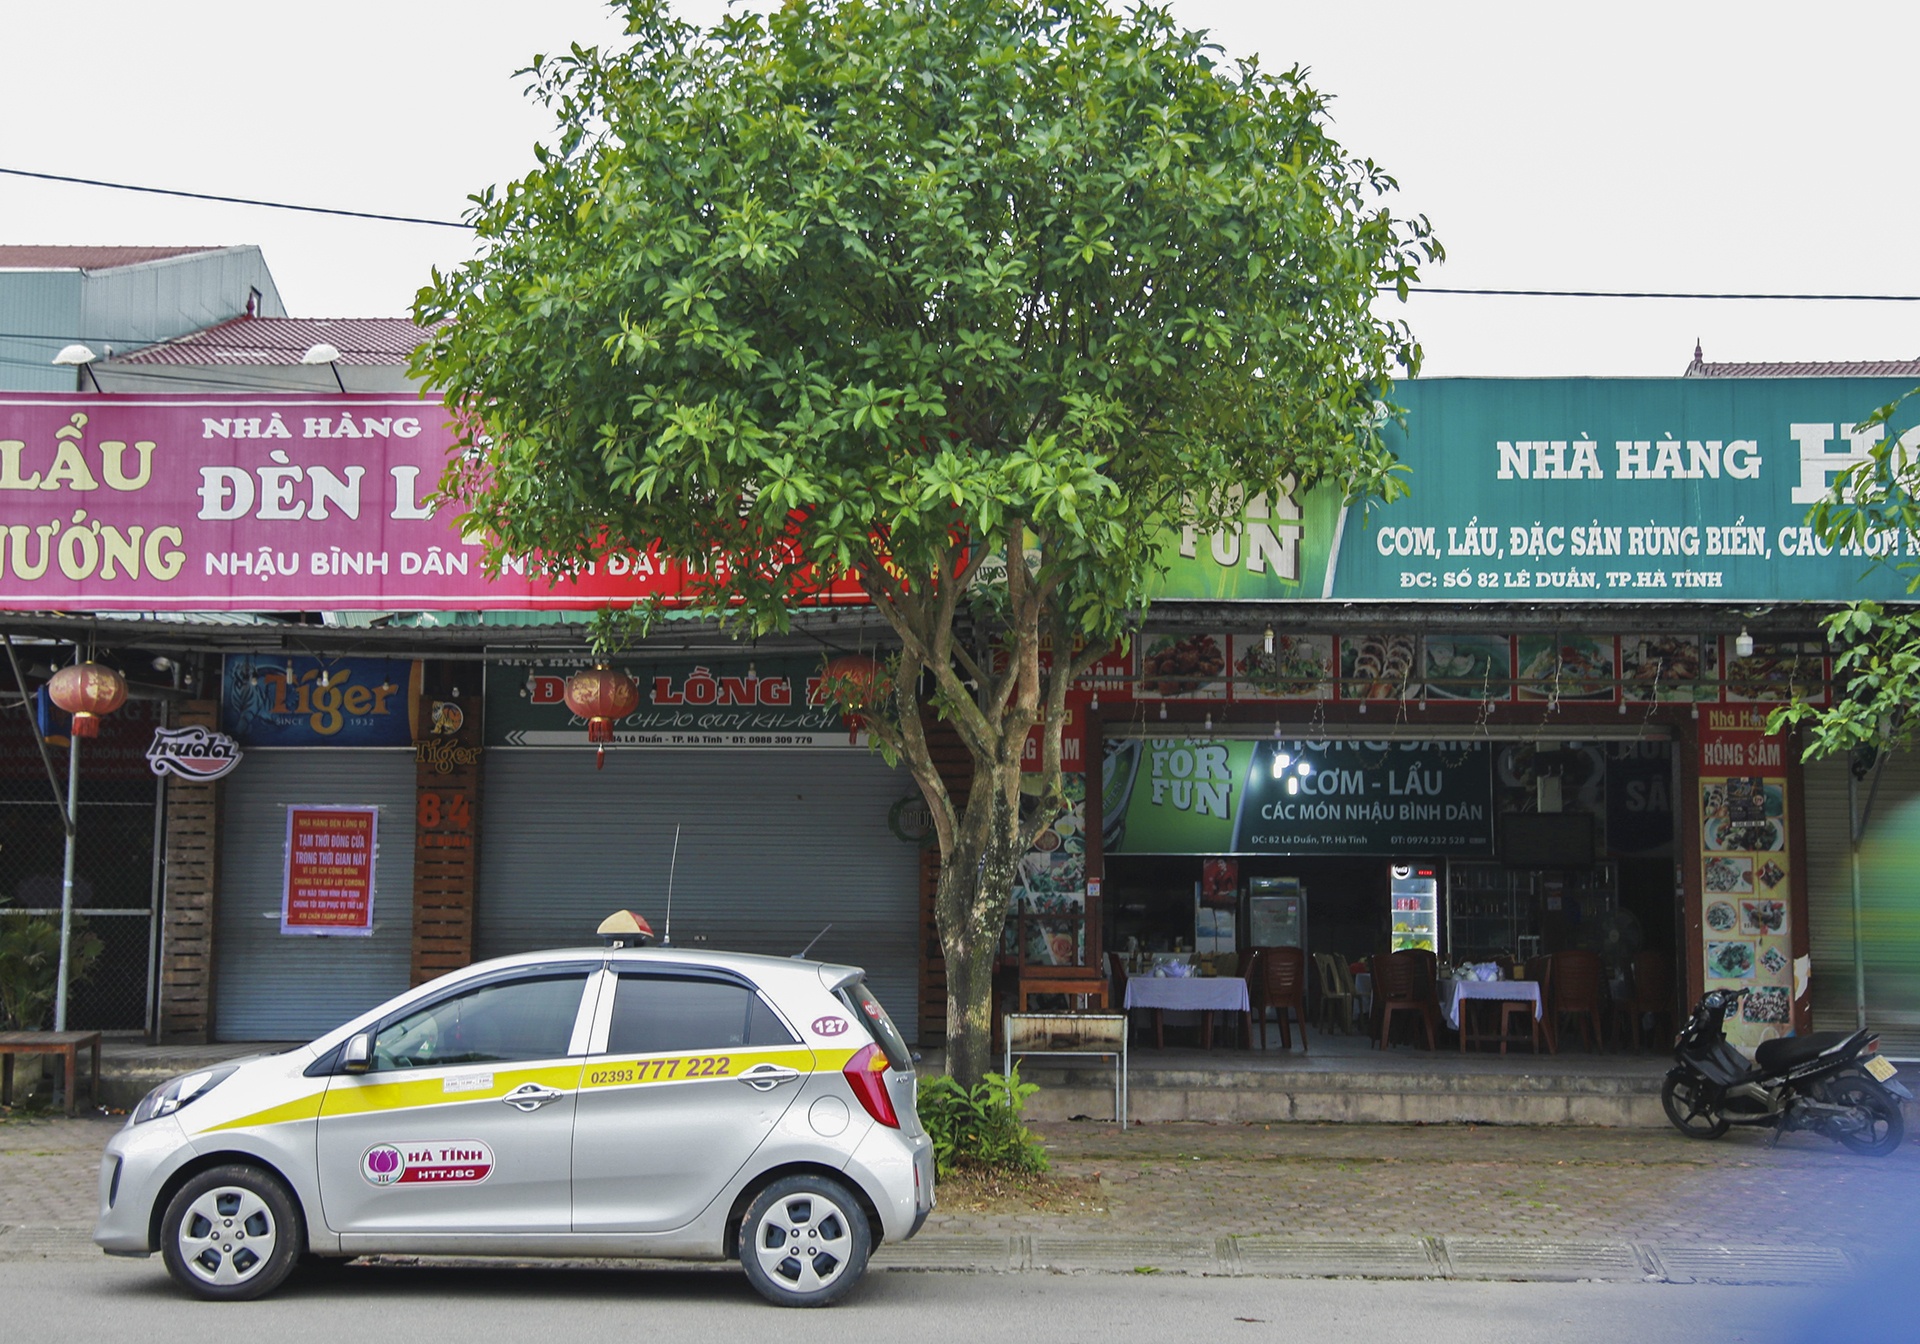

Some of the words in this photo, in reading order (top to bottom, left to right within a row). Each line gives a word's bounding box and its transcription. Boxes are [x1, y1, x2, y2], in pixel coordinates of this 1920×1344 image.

[202, 412, 292, 439] NHÀ
[302, 412, 422, 439] HÀNG
[0, 412, 157, 492] LẨU
[1497, 432, 1604, 480] NHÀ
[1615, 432, 1763, 480] HÀNG
[197, 449, 366, 521] ĐÈN
[0, 509, 187, 582] ƯỚNG
[1179, 521, 1303, 580] FUN
[1377, 526, 1441, 560] CƠM,
[1448, 515, 1504, 560] LẨU,
[1509, 520, 1565, 562] ĐẶC
[1570, 518, 1622, 556] SẢN
[1627, 519, 1700, 556] RỪNG
[1706, 515, 1772, 560] BIỂN,
[205, 546, 300, 582] NHẬU
[311, 546, 389, 576] BÌNH
[400, 546, 468, 576] DÂN
[1400, 571, 1437, 588] ĐC:
[1443, 567, 1473, 588] SỐ
[1477, 571, 1499, 588] 82
[1504, 569, 1531, 588] LÊ
[264, 669, 399, 735] Tiger
[652, 665, 792, 706] LỒNG
[276, 717, 303, 726] SINCE
[349, 718, 375, 726] 1932
[625, 710, 694, 728] CHÀO
[148, 730, 236, 762] huda
[411, 738, 483, 774] Tiger
[1151, 744, 1232, 780] FOR
[1748, 739, 1780, 766] SÂM
[1300, 767, 1364, 795] CƠM
[1389, 760, 1443, 795] LẨU
[418, 793, 472, 828] 84
[1151, 779, 1232, 819] FUN
[1261, 801, 1295, 820] CÁC
[1300, 801, 1341, 820] MÓN
[1345, 801, 1395, 825] NHẬU
[1399, 801, 1441, 820] BÌNH
[1445, 801, 1483, 820] DÂN
[1268, 836, 1280, 844] 82
[1406, 836, 1429, 845] 0974
[1430, 836, 1447, 845] 232
[1449, 836, 1465, 845] 528
[815, 1020, 845, 1034] 127
[591, 1069, 633, 1084] 02393
[637, 1060, 680, 1080] 777
[685, 1057, 730, 1077] 222
[408, 1149, 433, 1162] HÀ
[418, 1169, 475, 1179] HTTJSC
